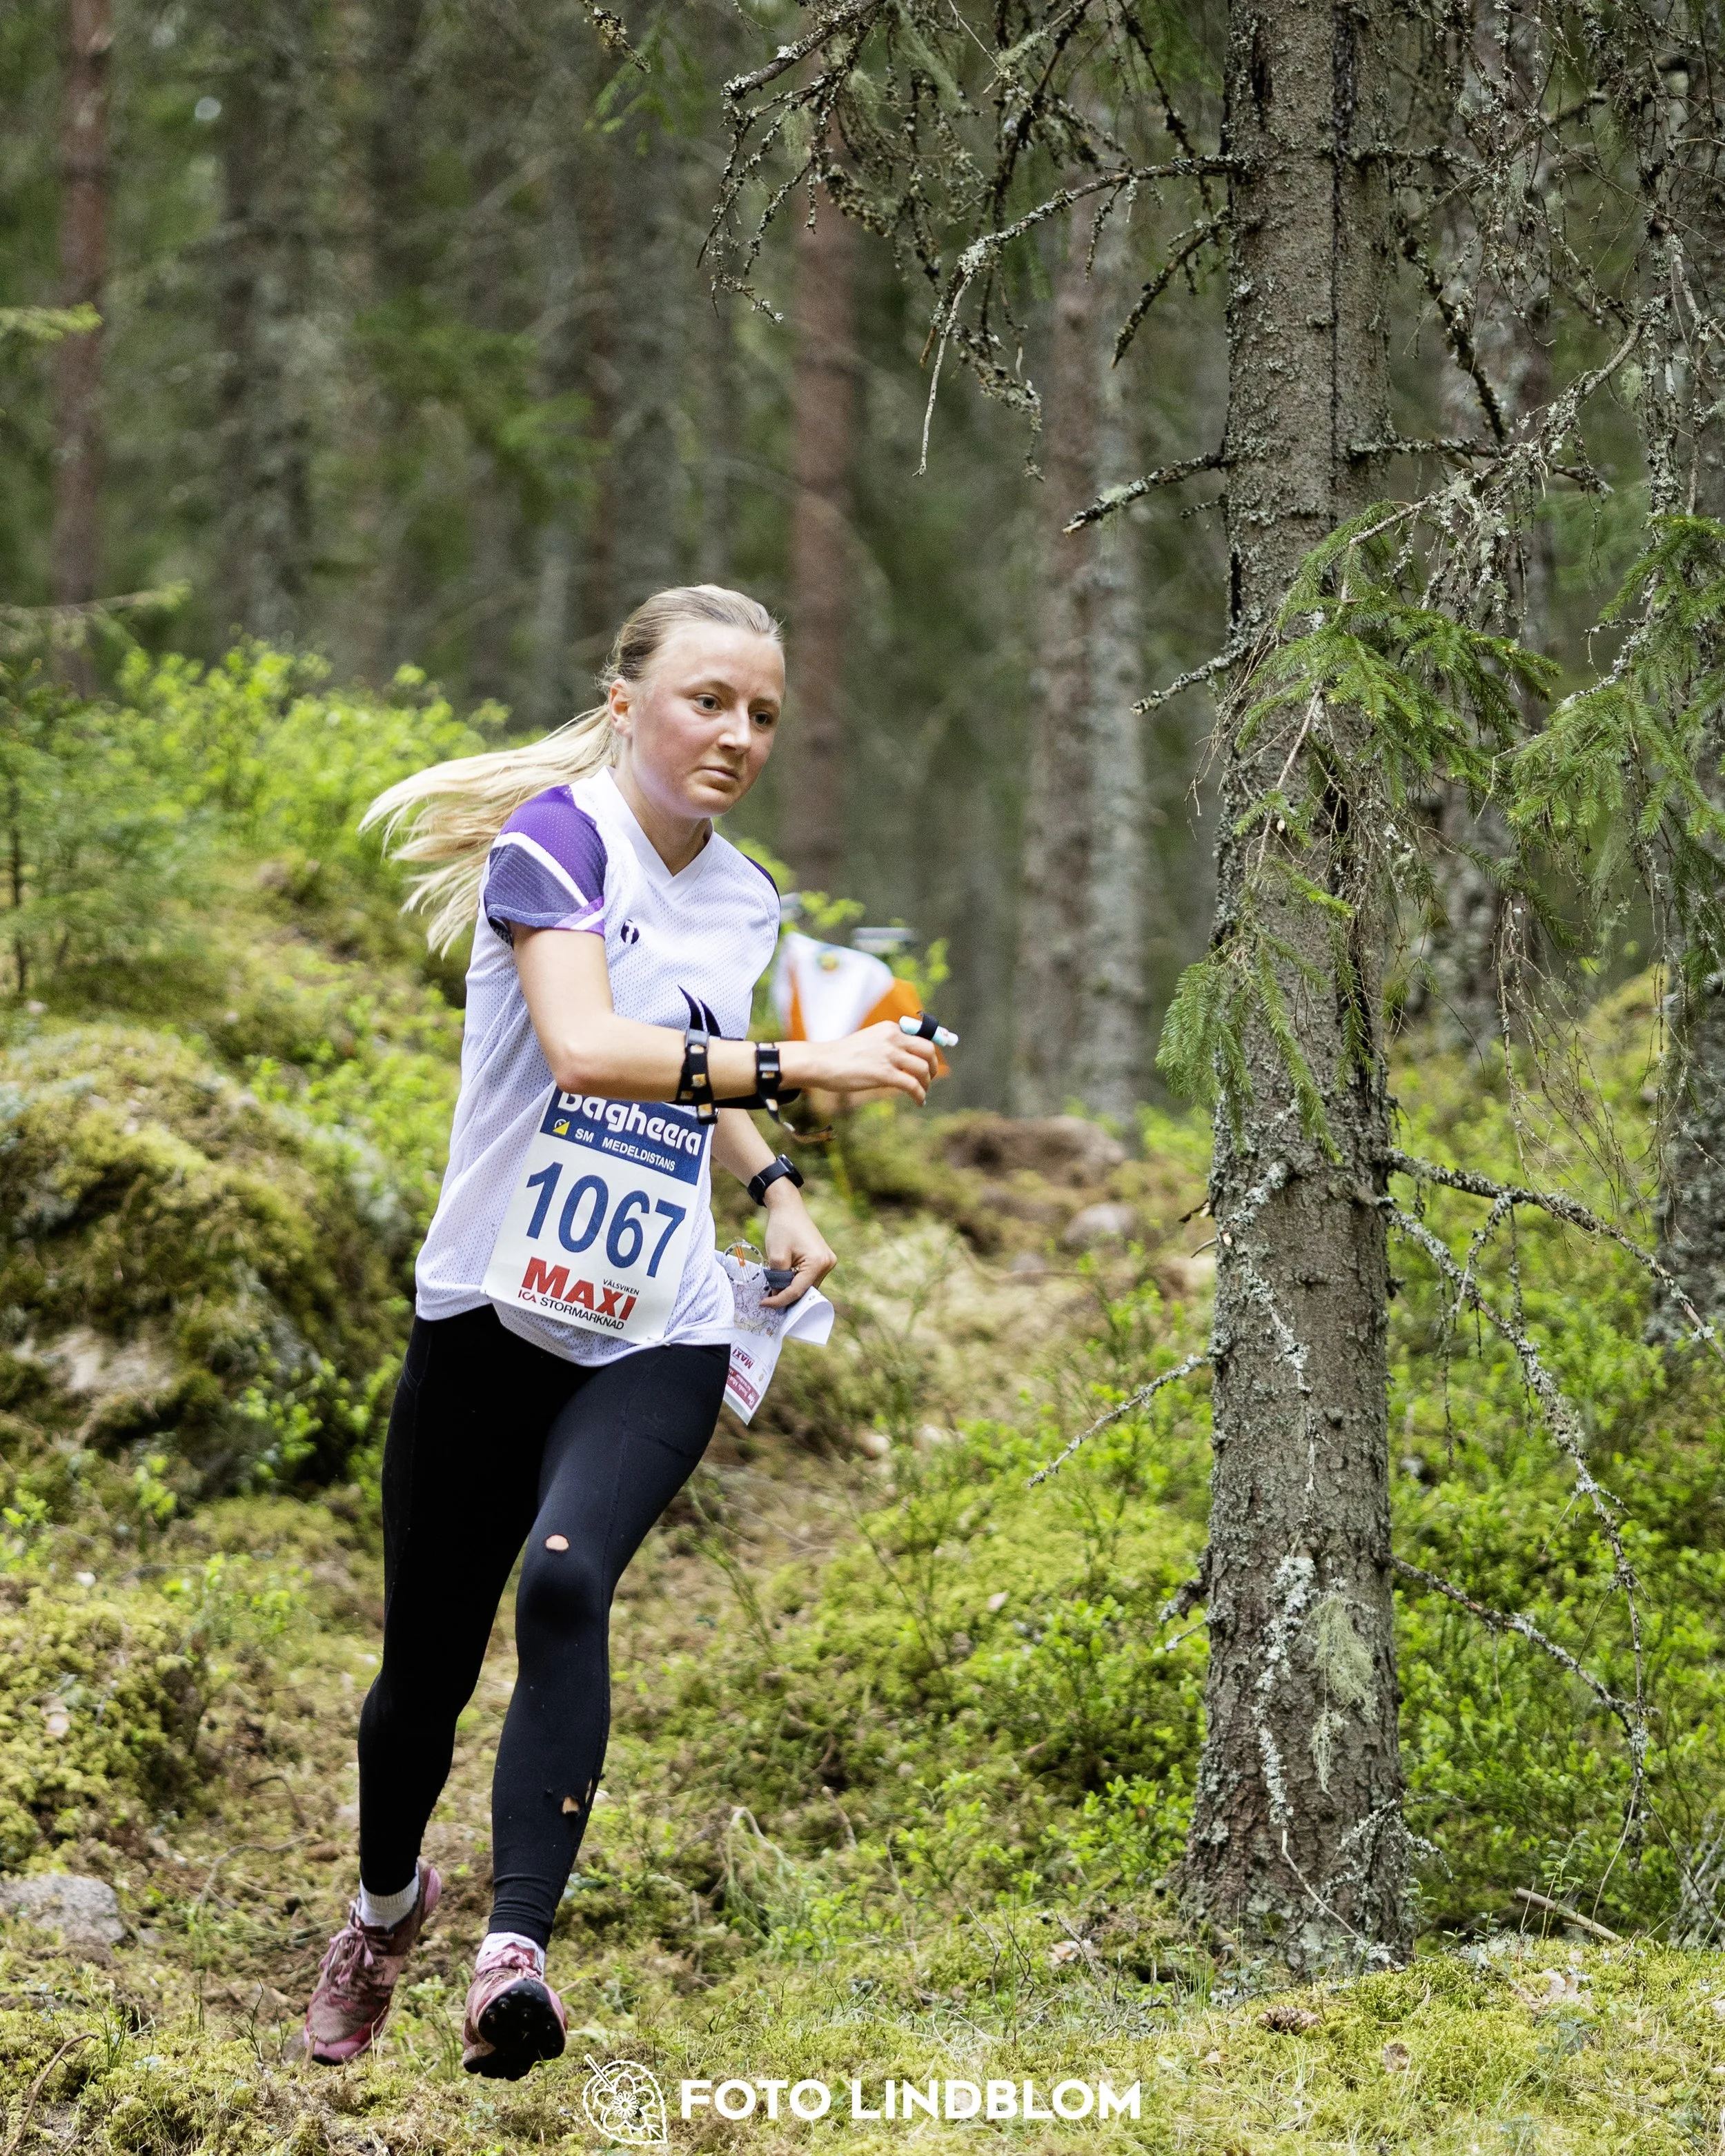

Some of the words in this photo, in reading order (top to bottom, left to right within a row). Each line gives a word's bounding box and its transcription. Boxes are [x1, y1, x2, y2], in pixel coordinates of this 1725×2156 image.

[575, 1128, 594, 1143] SM
[602, 1137, 676, 1171] MEDELDISTANS
[526, 1161, 687, 1278] 1067
[522, 1256, 637, 1321] MAXI
[603, 1278, 640, 1296] VÄLSVIKEN
[518, 1289, 537, 1303] ICA
[540, 1297, 624, 1330] STORMARKNAD
[732, 1349, 753, 1369] MAXI
